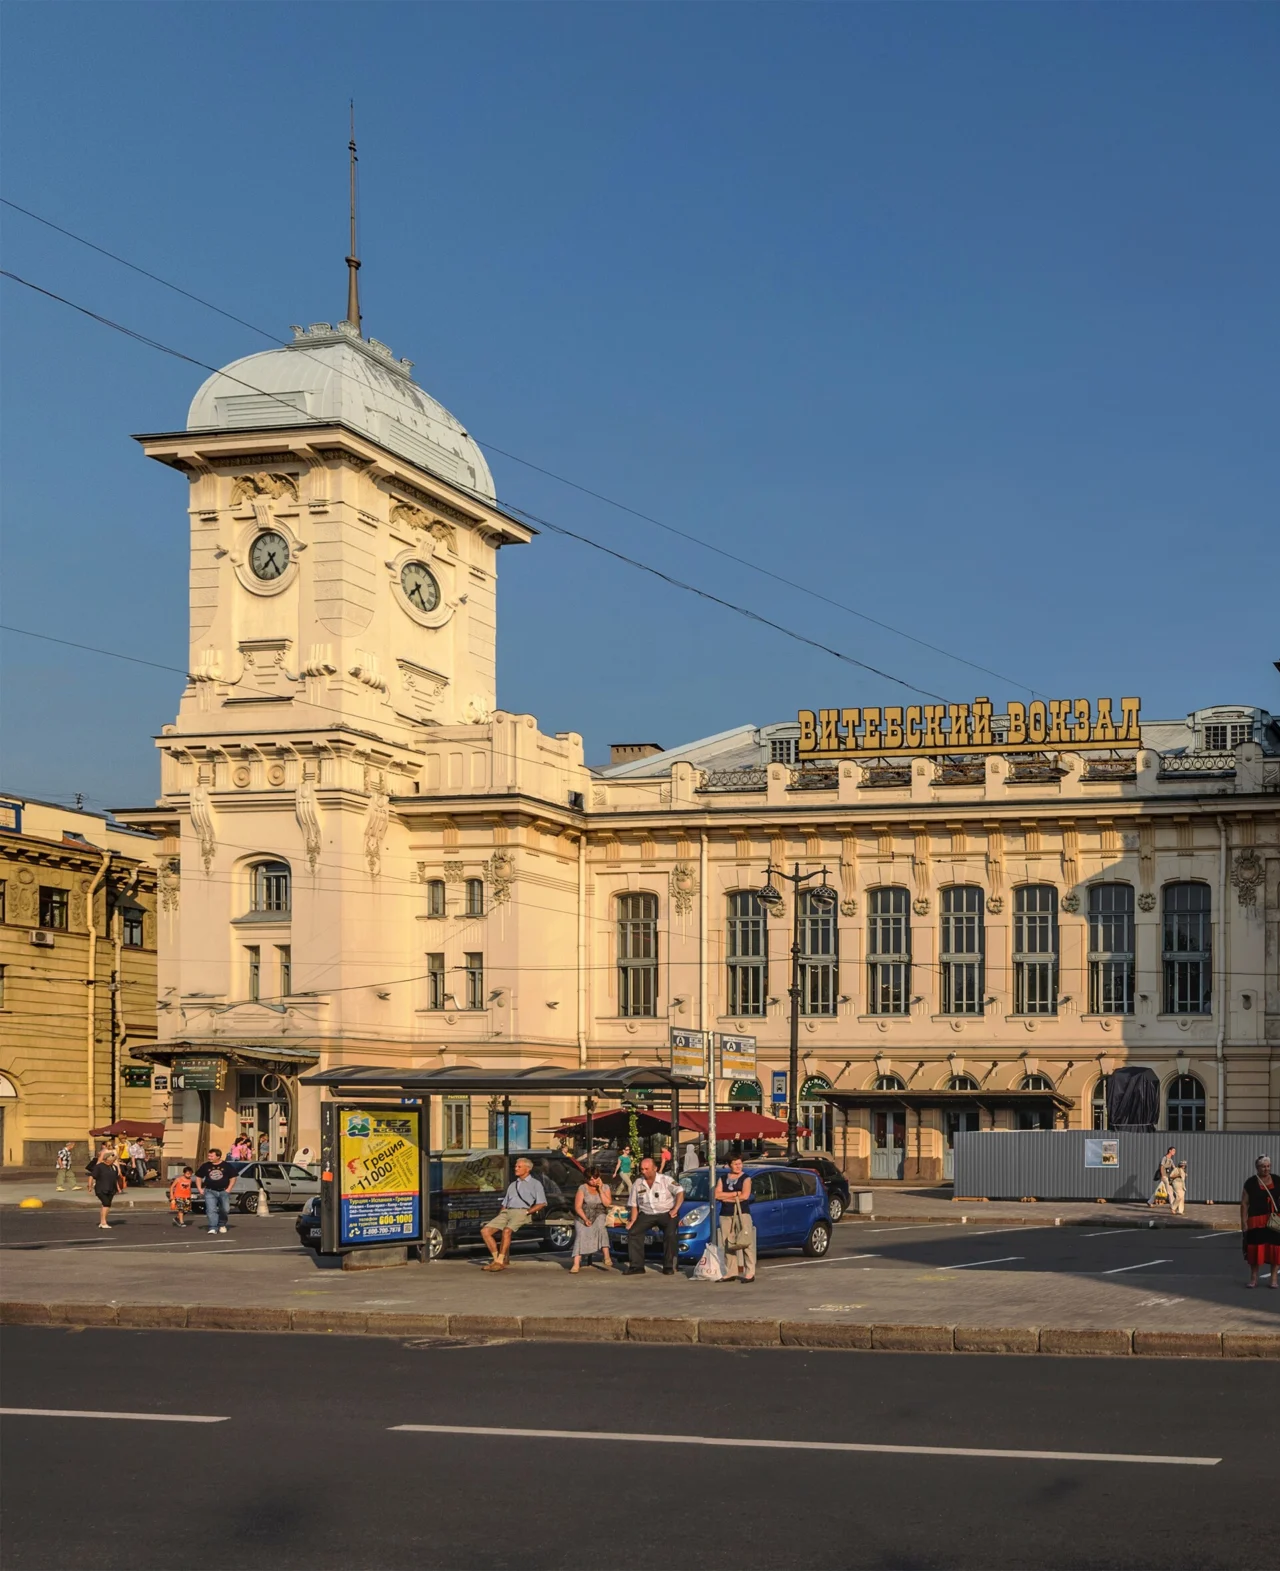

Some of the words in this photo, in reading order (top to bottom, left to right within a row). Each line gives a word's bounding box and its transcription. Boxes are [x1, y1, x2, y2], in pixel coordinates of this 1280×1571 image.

[797, 696, 994, 752] ВИТЕБСКИЙ
[1006, 697, 1142, 744] ВОКЗАЛ
[373, 1119, 411, 1128] TEZ
[363, 1139, 405, 1171] Греция
[379, 1214, 413, 1225] 600-1000
